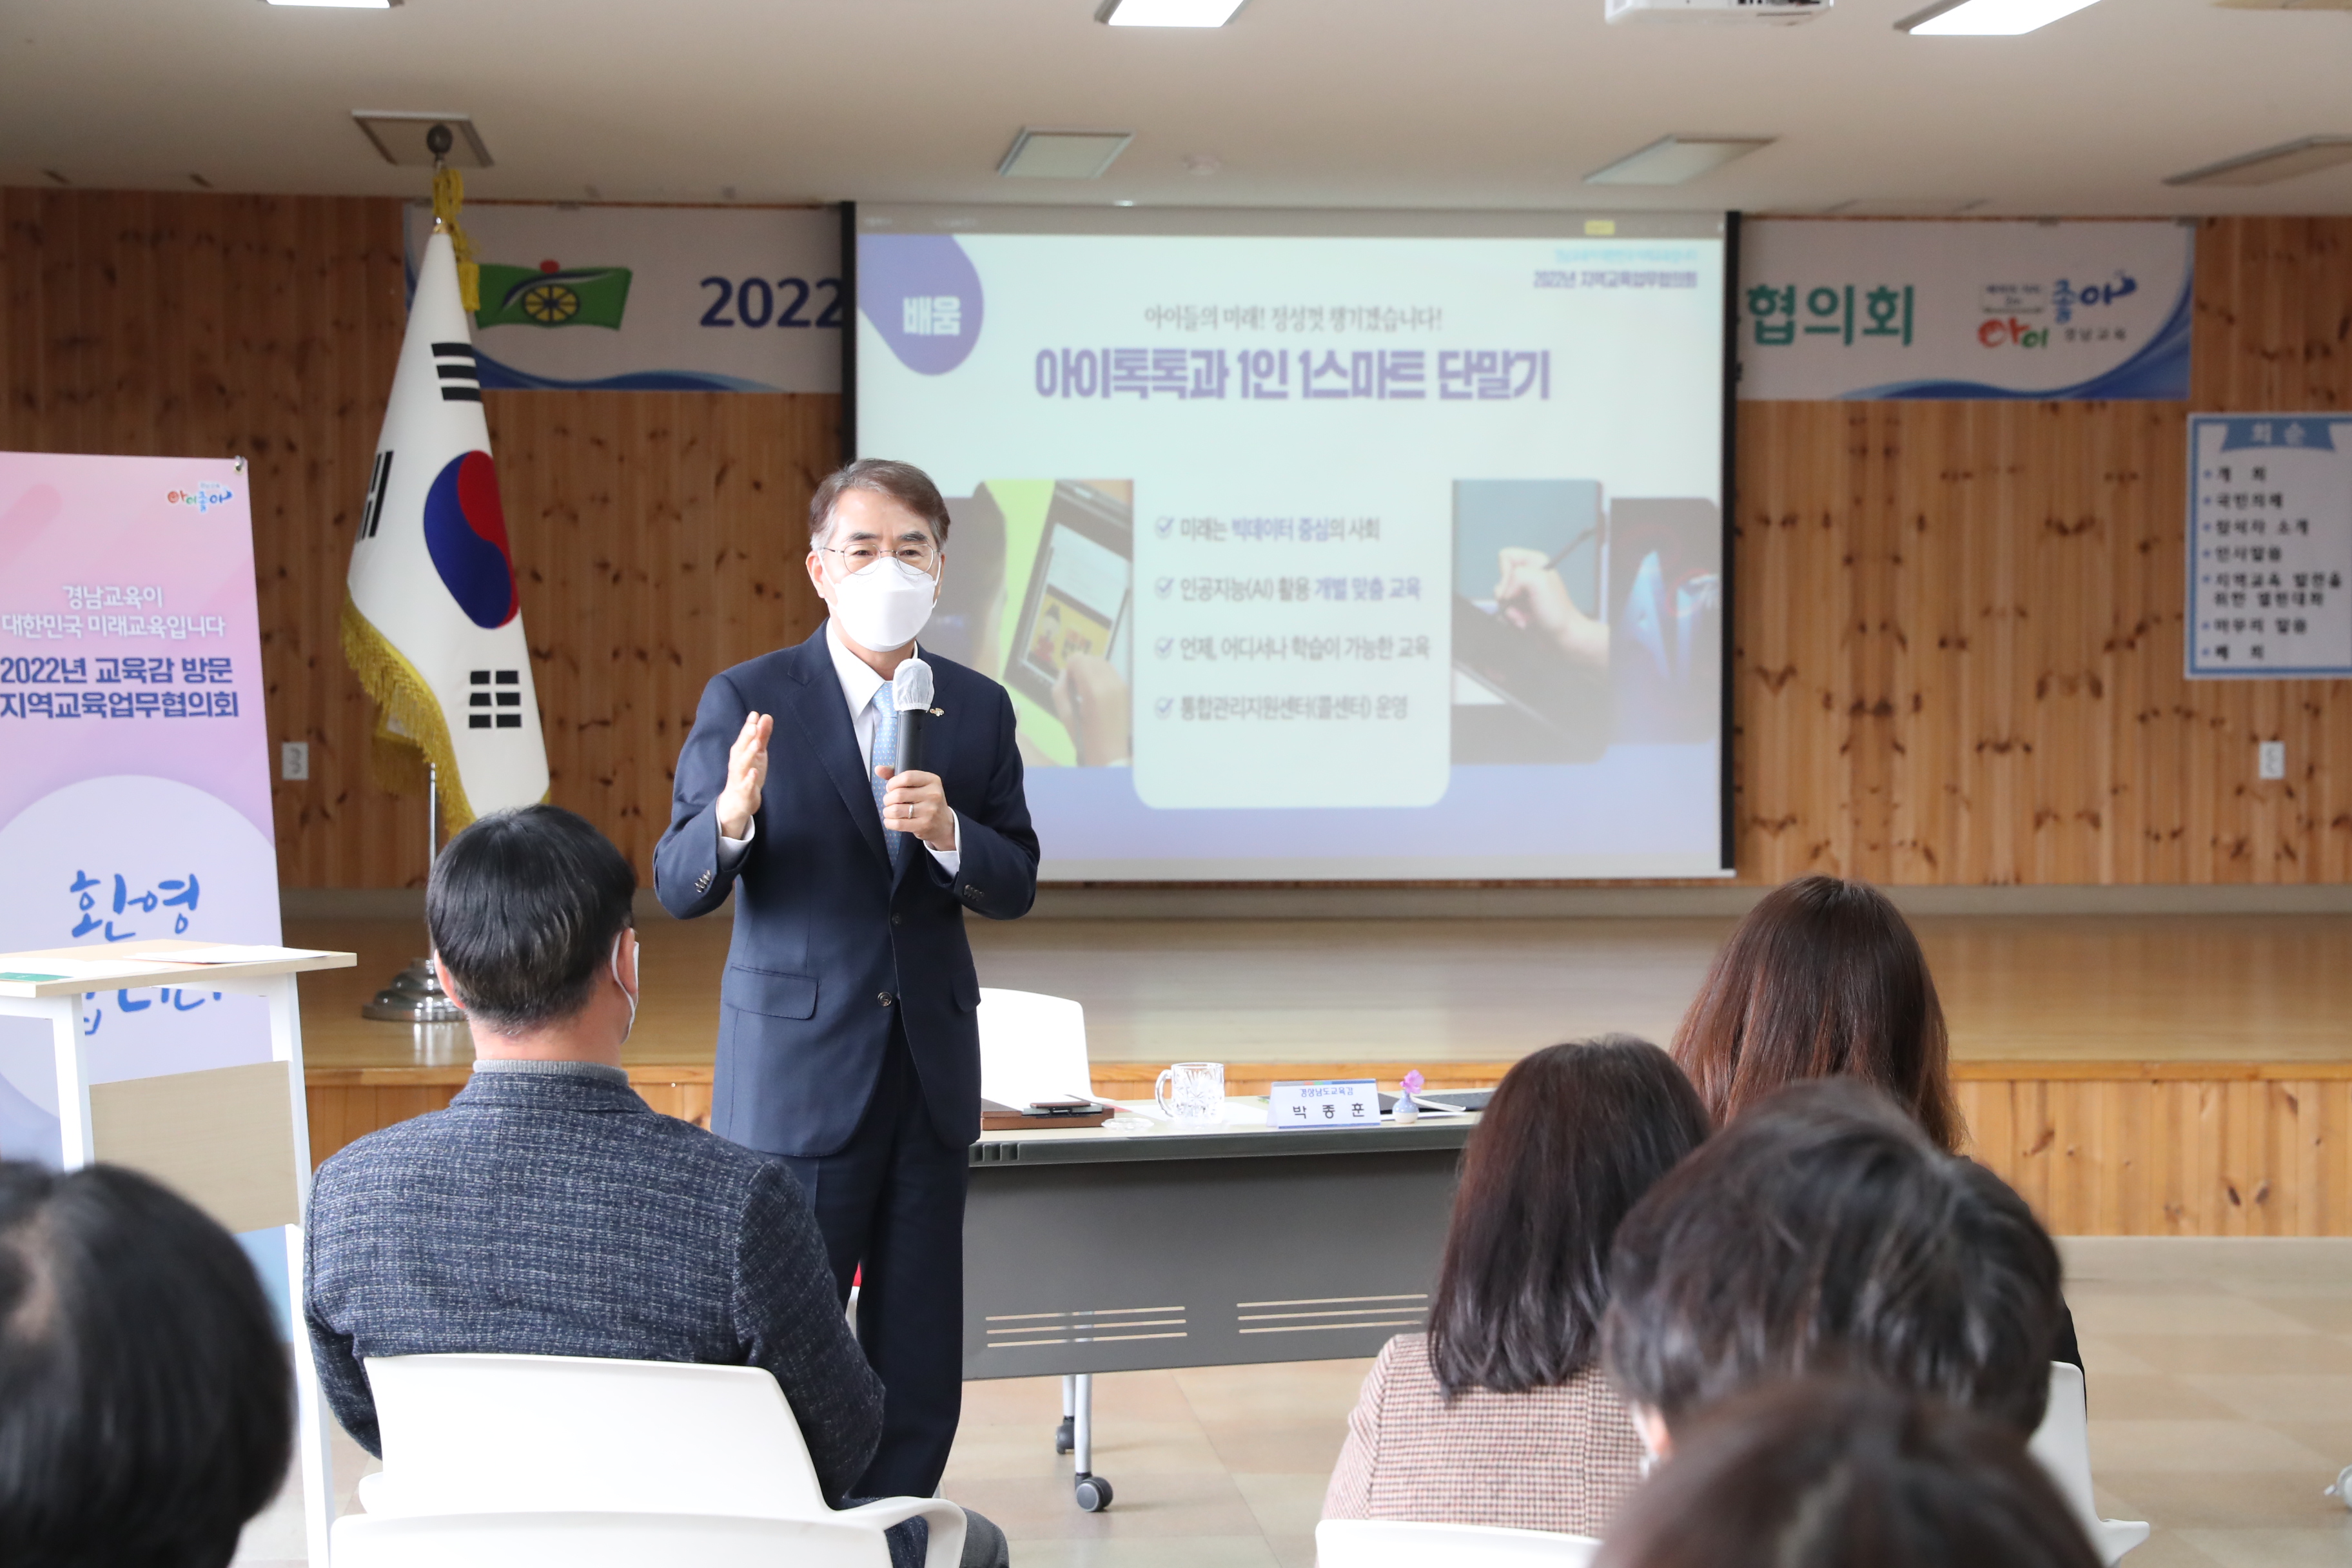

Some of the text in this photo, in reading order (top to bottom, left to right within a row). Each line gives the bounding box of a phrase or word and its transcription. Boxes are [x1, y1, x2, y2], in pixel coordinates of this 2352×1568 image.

[700, 276, 843, 329] 2022
[903, 296, 961, 336] 배움
[1747, 283, 1914, 348] 협의회
[1144, 304, 1442, 332] 아이들의 미래! 정성껏 챙기겠습니다!
[1035, 347, 1551, 400] 아이톡톡과 1인 1스마트 단말기
[1180, 516, 1380, 542] 미래는 빅데이터 중심의 사회
[63, 585, 164, 610] 경남교육이
[1180, 576, 1422, 602] 인공지능(AI) 활용 개별 맞춤 교육
[1, 614, 226, 640] 대한민국 미래교육입니다
[1180, 636, 1431, 662] 언제, 어디서나 학습이 가능한 교육
[1, 657, 233, 684] 2022년 교육감 방문
[0, 691, 239, 719] 지역교육업무협의회
[1180, 694, 1408, 721] 통합관리지원센터(콜센터) 운영
[70, 870, 201, 942] 환영
[1299, 1086, 1354, 1098] 경상남도교육감
